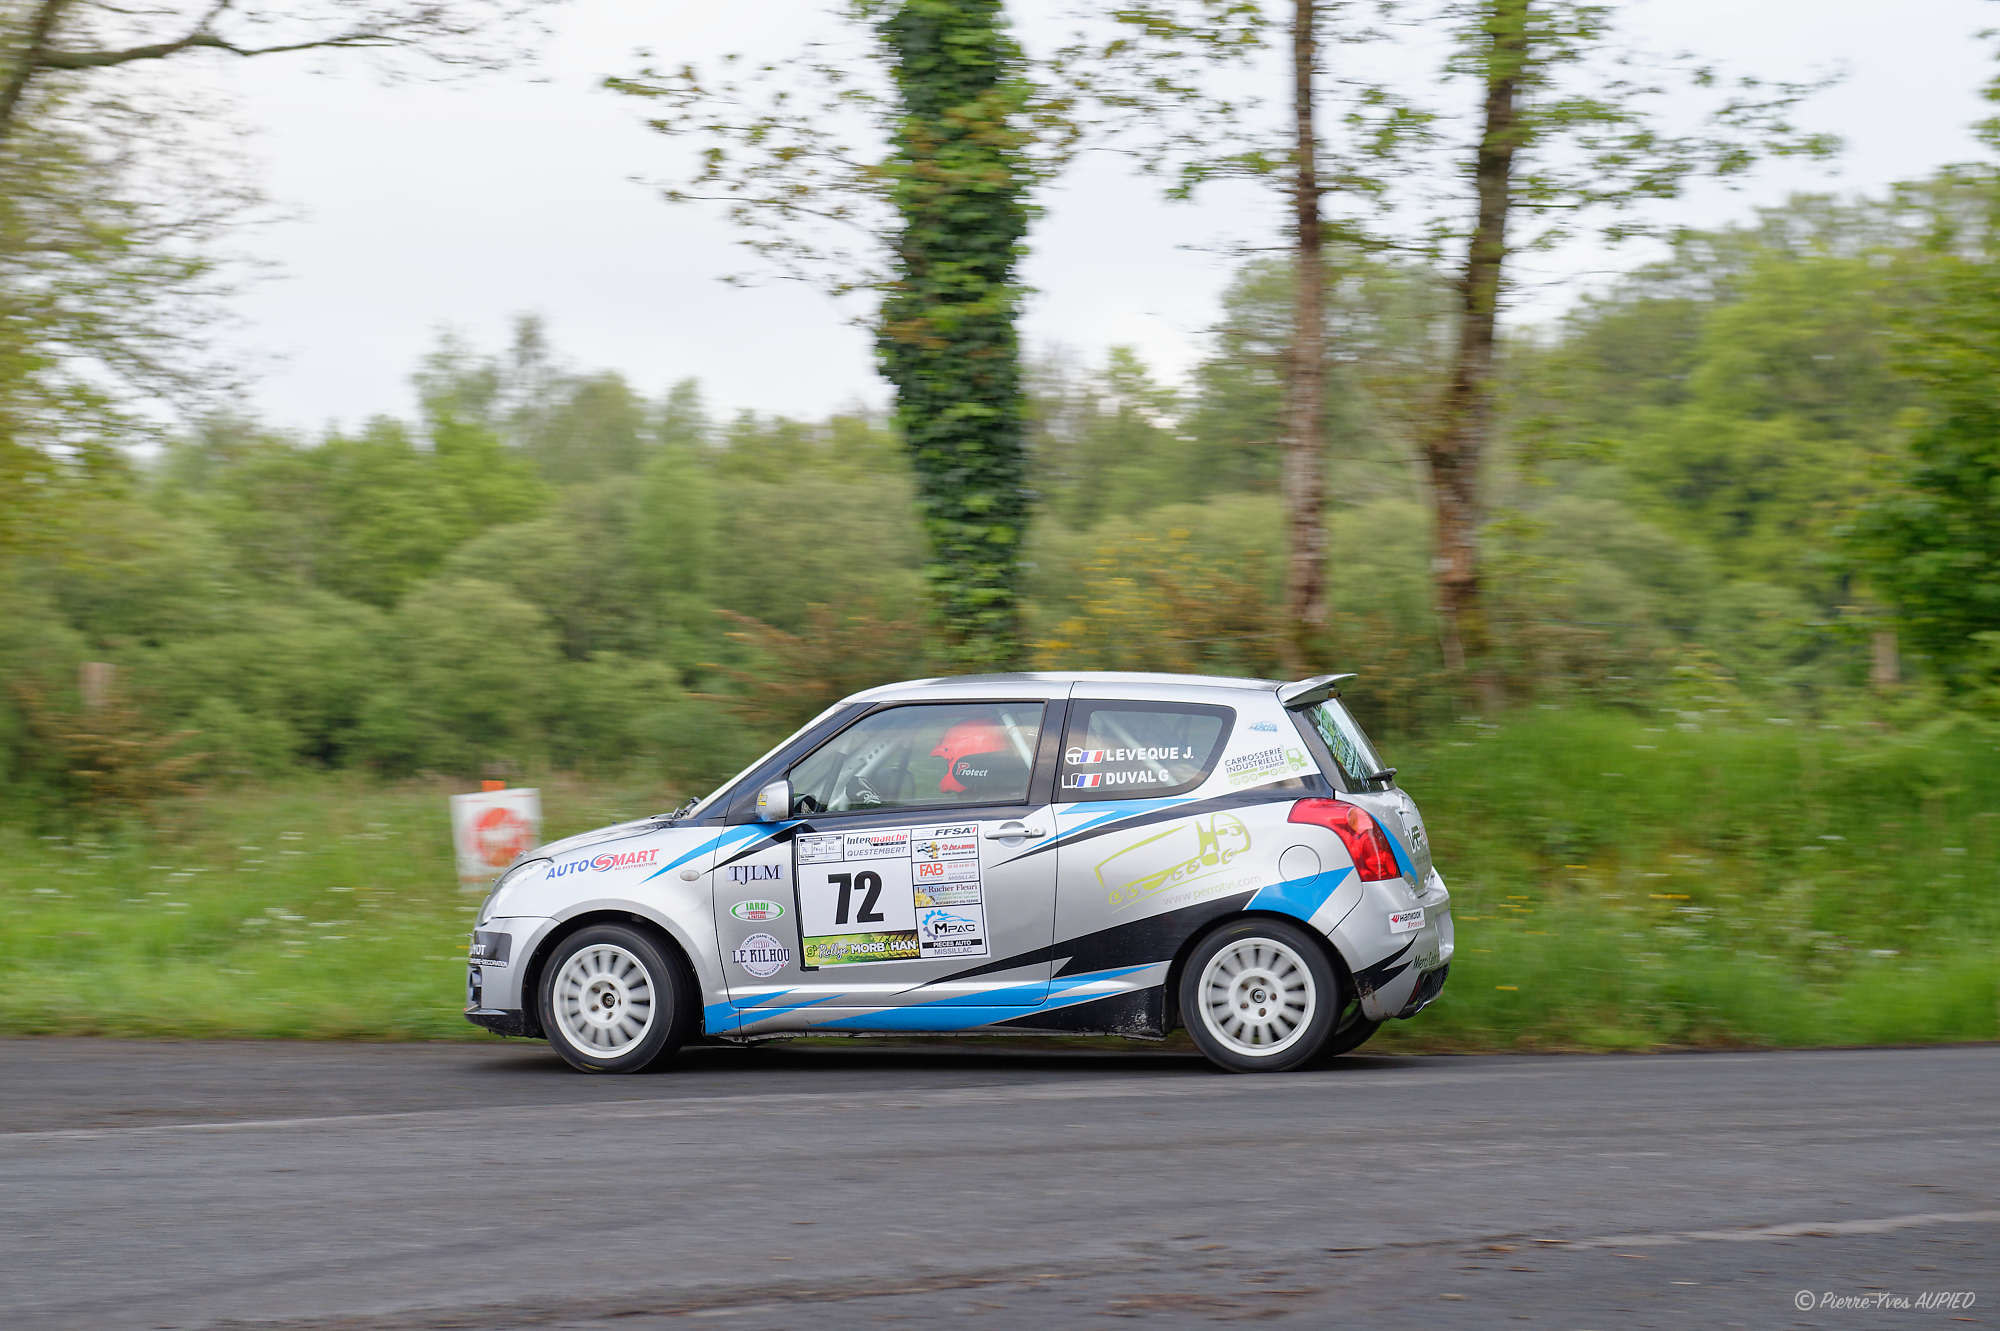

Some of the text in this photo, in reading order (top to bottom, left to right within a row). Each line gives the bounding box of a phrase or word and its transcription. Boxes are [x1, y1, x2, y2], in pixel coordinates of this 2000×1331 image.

[1106, 746, 1194, 761] LEVEQUE J.
[1225, 748, 1282, 767] CARROSSERIE
[956, 762, 988, 777] Protect
[1226, 754, 1284, 773] INDUSTRIELLE
[1105, 769, 1169, 784] DUVAL G
[935, 827, 971, 836] FFSA
[846, 846, 906, 857] QUESTEMBERT
[729, 864, 781, 885] TJLM
[920, 863, 944, 877] FAB
[928, 884, 955, 893] Rucher
[957, 882, 978, 891] Fleuri
[828, 870, 885, 925] 72
[934, 923, 976, 934] MPAC
[732, 948, 790, 963] LE KILHOU
[934, 947, 973, 955] MISSILLAC
